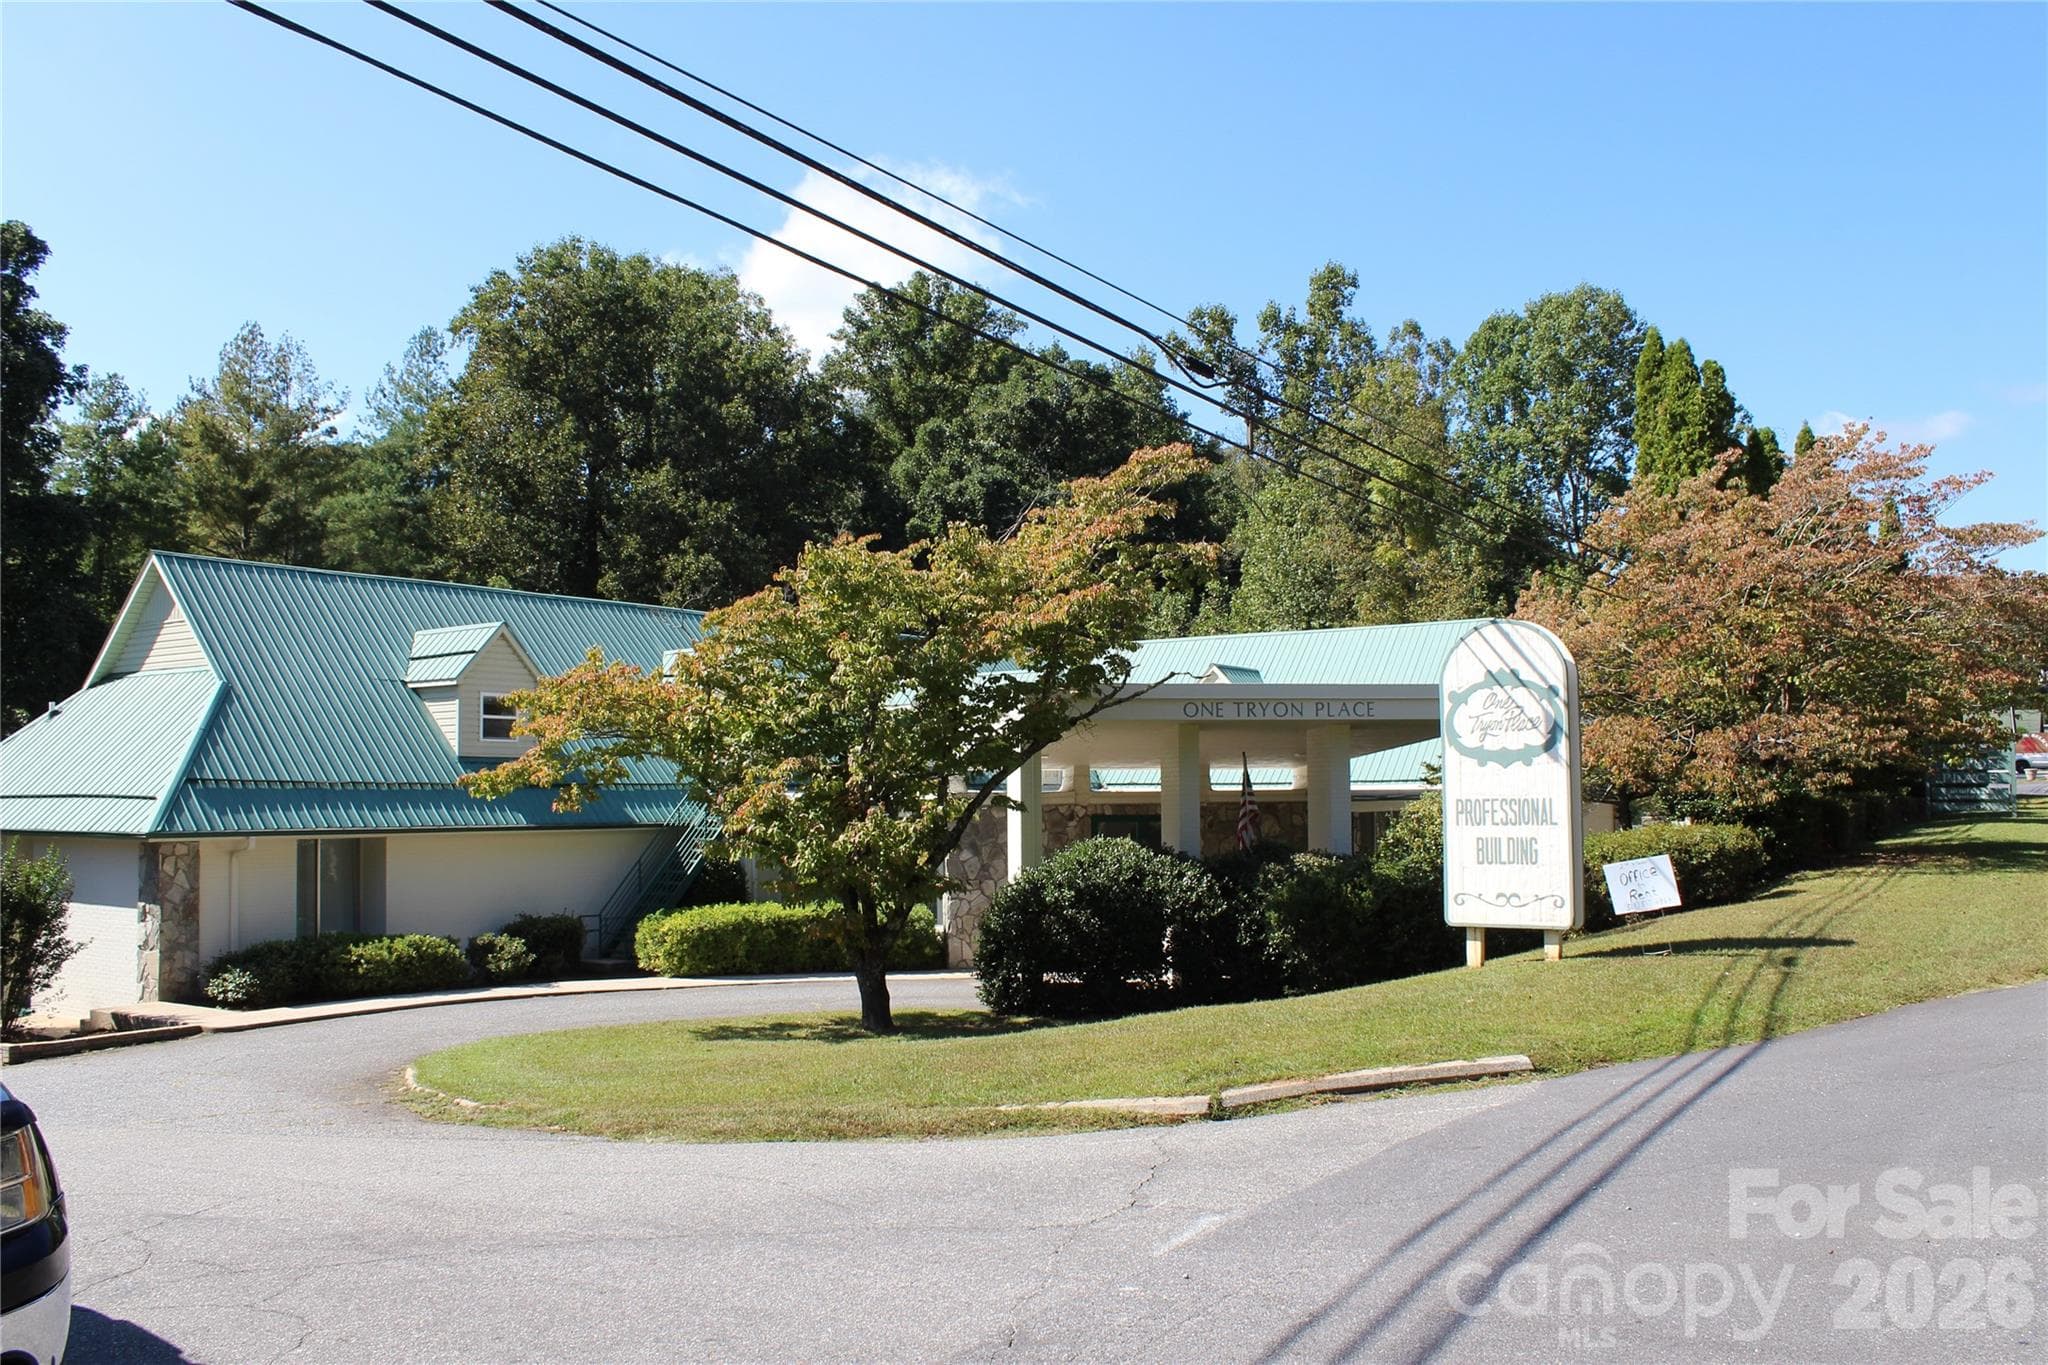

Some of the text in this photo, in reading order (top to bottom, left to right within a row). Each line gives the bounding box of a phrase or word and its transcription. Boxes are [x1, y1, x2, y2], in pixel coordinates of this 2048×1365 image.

[1183, 701, 1375, 718] ONE TRYON PLACE
[1483, 692, 1512, 710] One
[1468, 706, 1542, 742] Tryon Place
[1455, 797, 1559, 827] PROFESSIONAL
[1475, 836, 1539, 866] BUILDING
